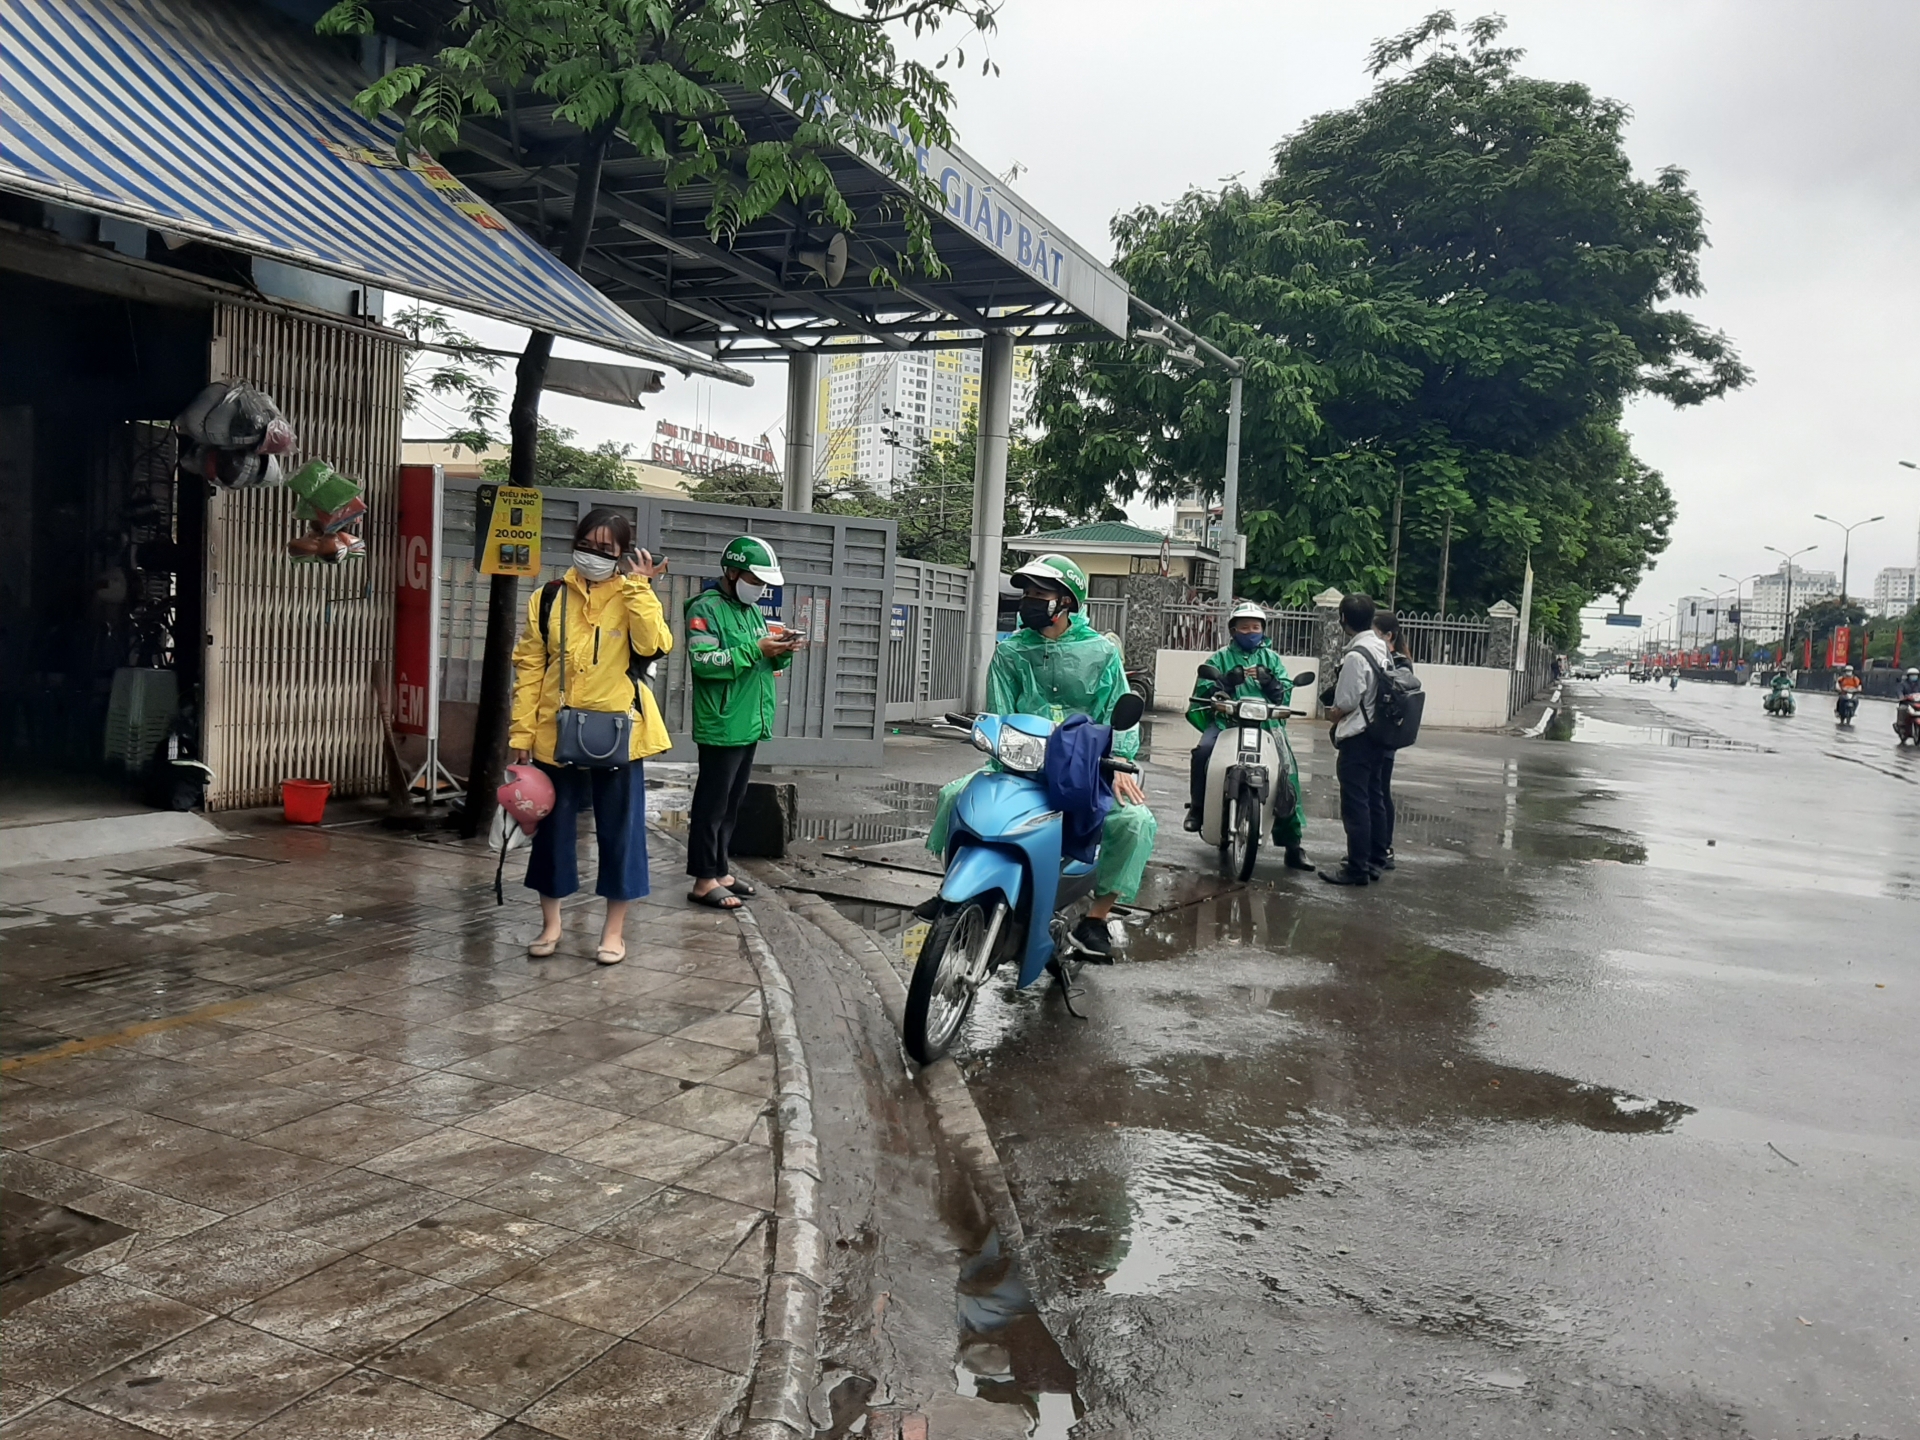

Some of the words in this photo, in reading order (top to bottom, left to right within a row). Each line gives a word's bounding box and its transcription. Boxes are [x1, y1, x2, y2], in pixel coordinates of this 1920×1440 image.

[940, 166, 1013, 250] GIÁP
[1016, 230, 1064, 288] BÁT
[726, 551, 746, 563] Grab
[1066, 569, 1085, 591] Grab
